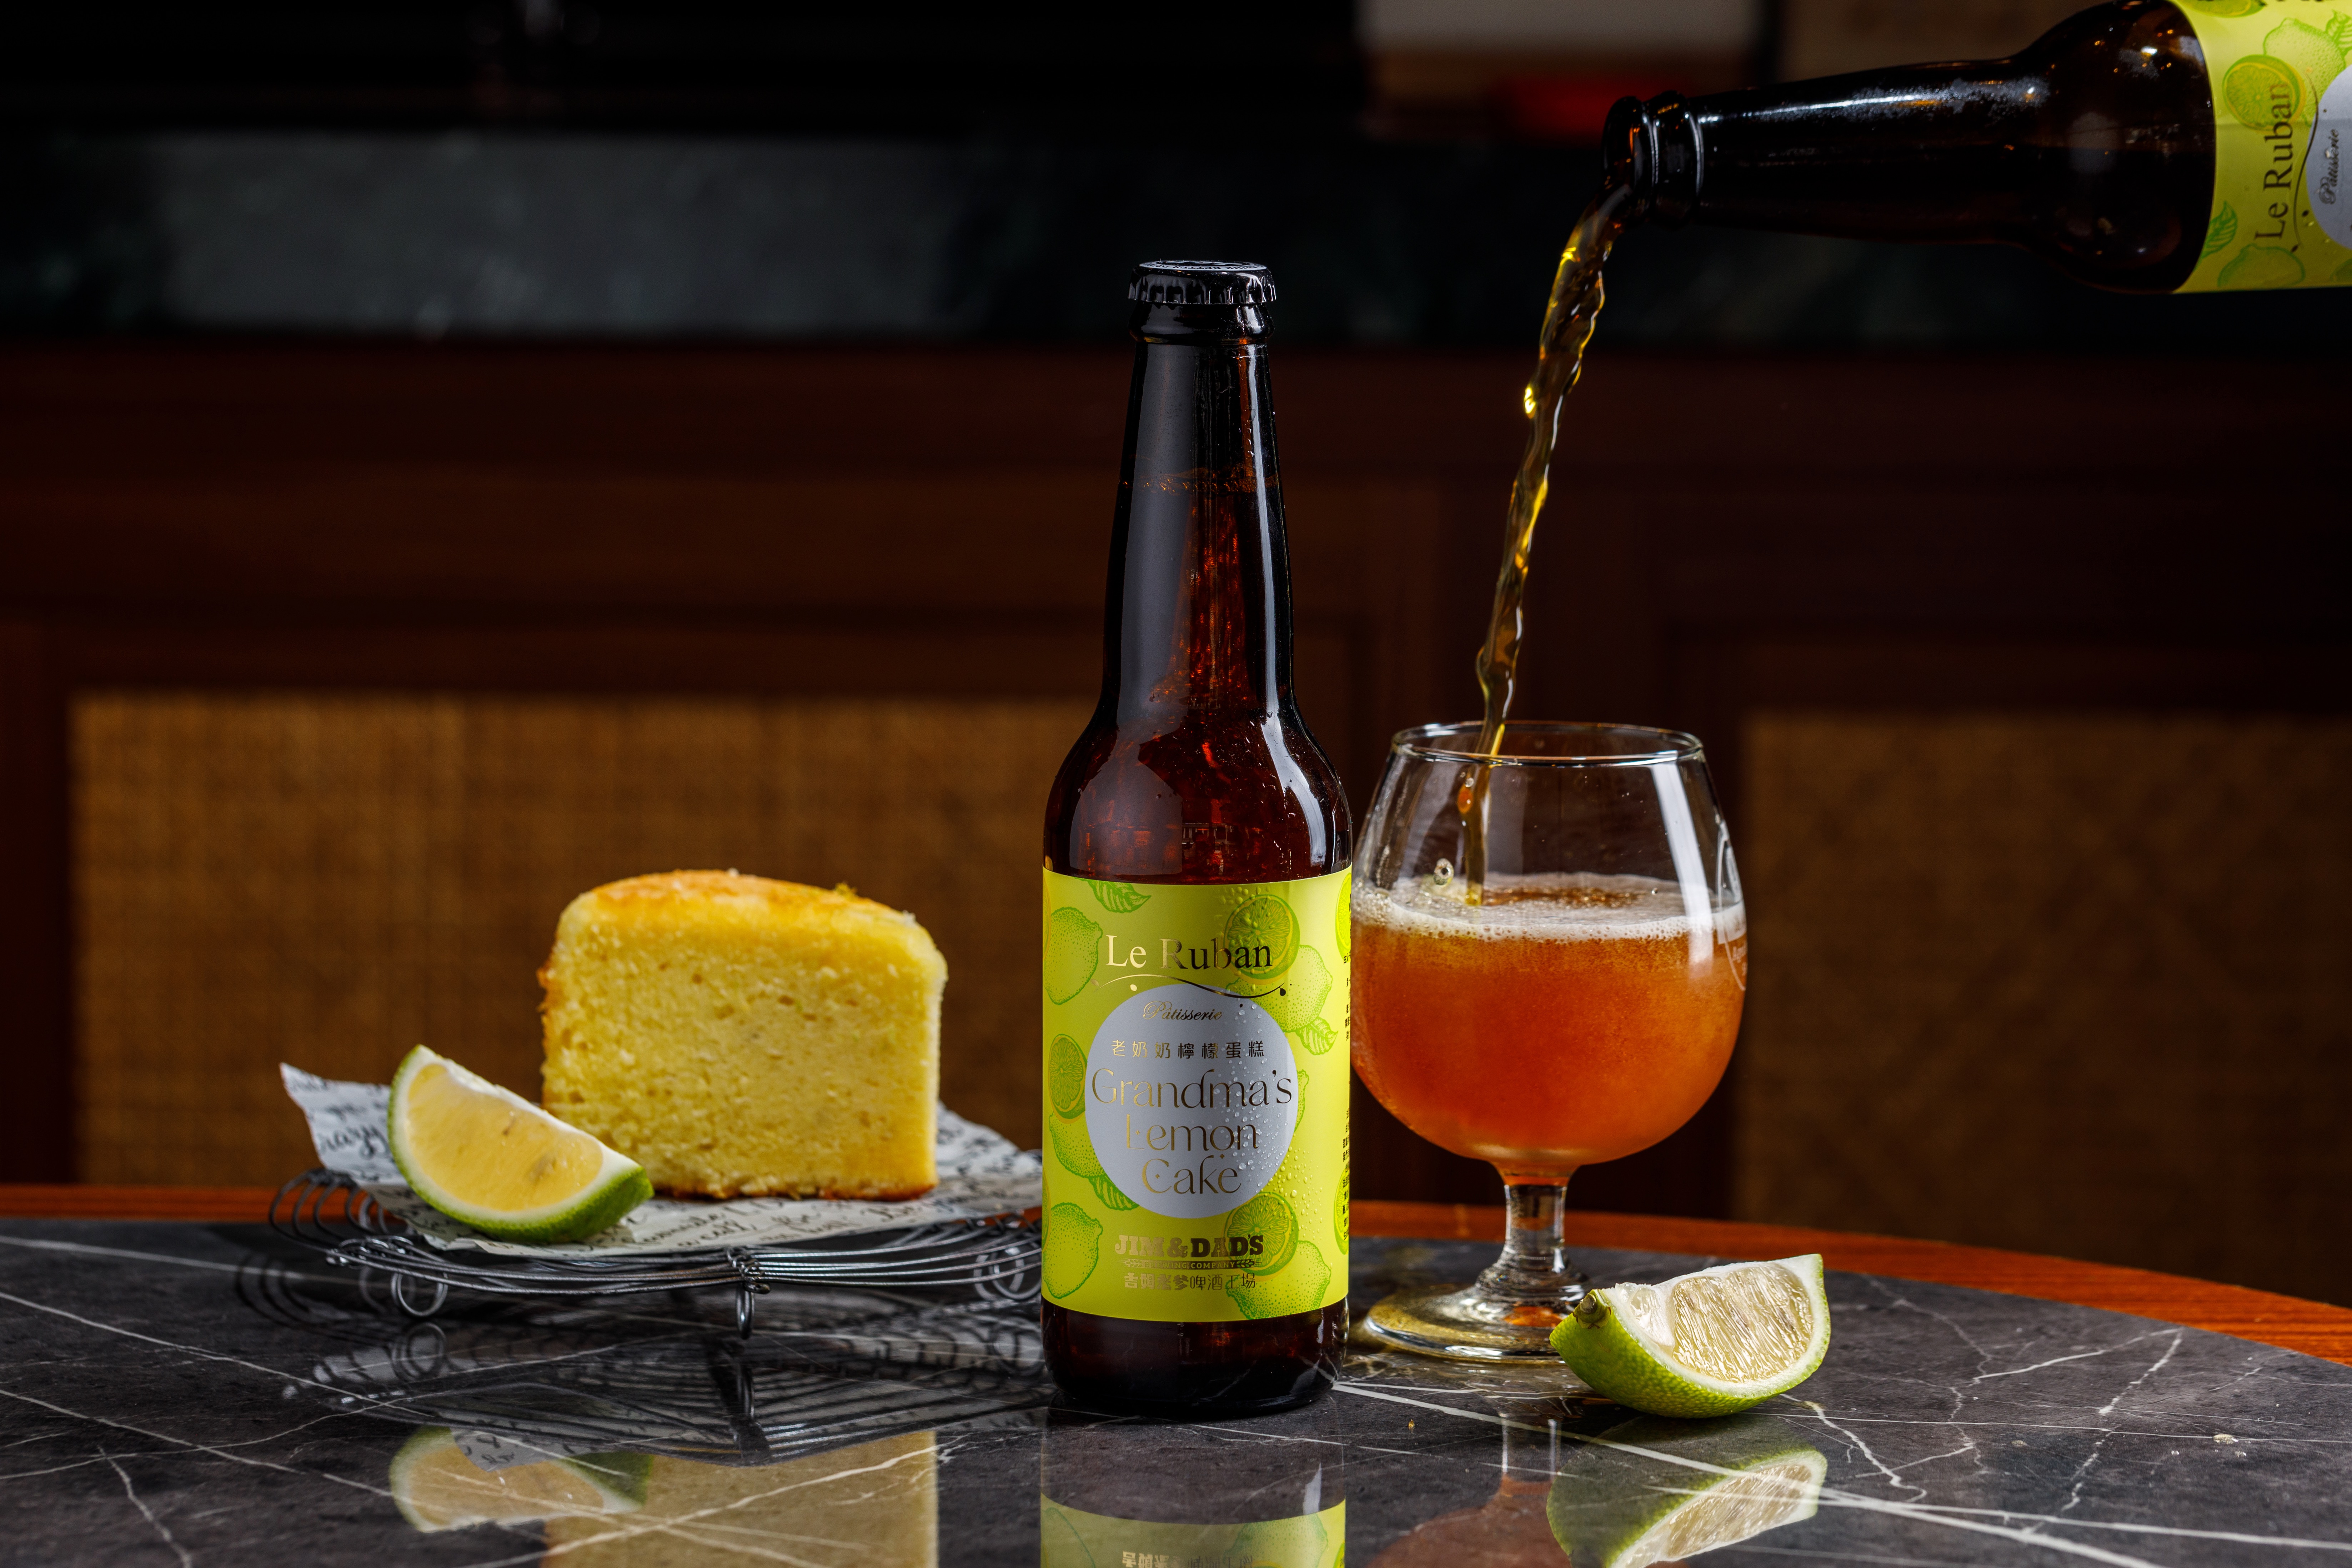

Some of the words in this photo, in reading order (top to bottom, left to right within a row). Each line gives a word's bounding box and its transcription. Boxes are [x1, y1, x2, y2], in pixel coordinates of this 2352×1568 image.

[2262, 82, 2293, 191] Ruban
[2255, 202, 2288, 240] Le
[1105, 935, 1147, 968] Le
[1159, 937, 1273, 970] Ruban
[1112, 1040, 1265, 1059] 老奶奶檸檬蛋糕
[1092, 1068, 1292, 1108] Grandma's
[1126, 1114, 1259, 1151] Lemon
[1142, 1154, 1242, 1194] Cake
[1124, 1272, 1255, 1291] 吉姆老爹啤酒工場
